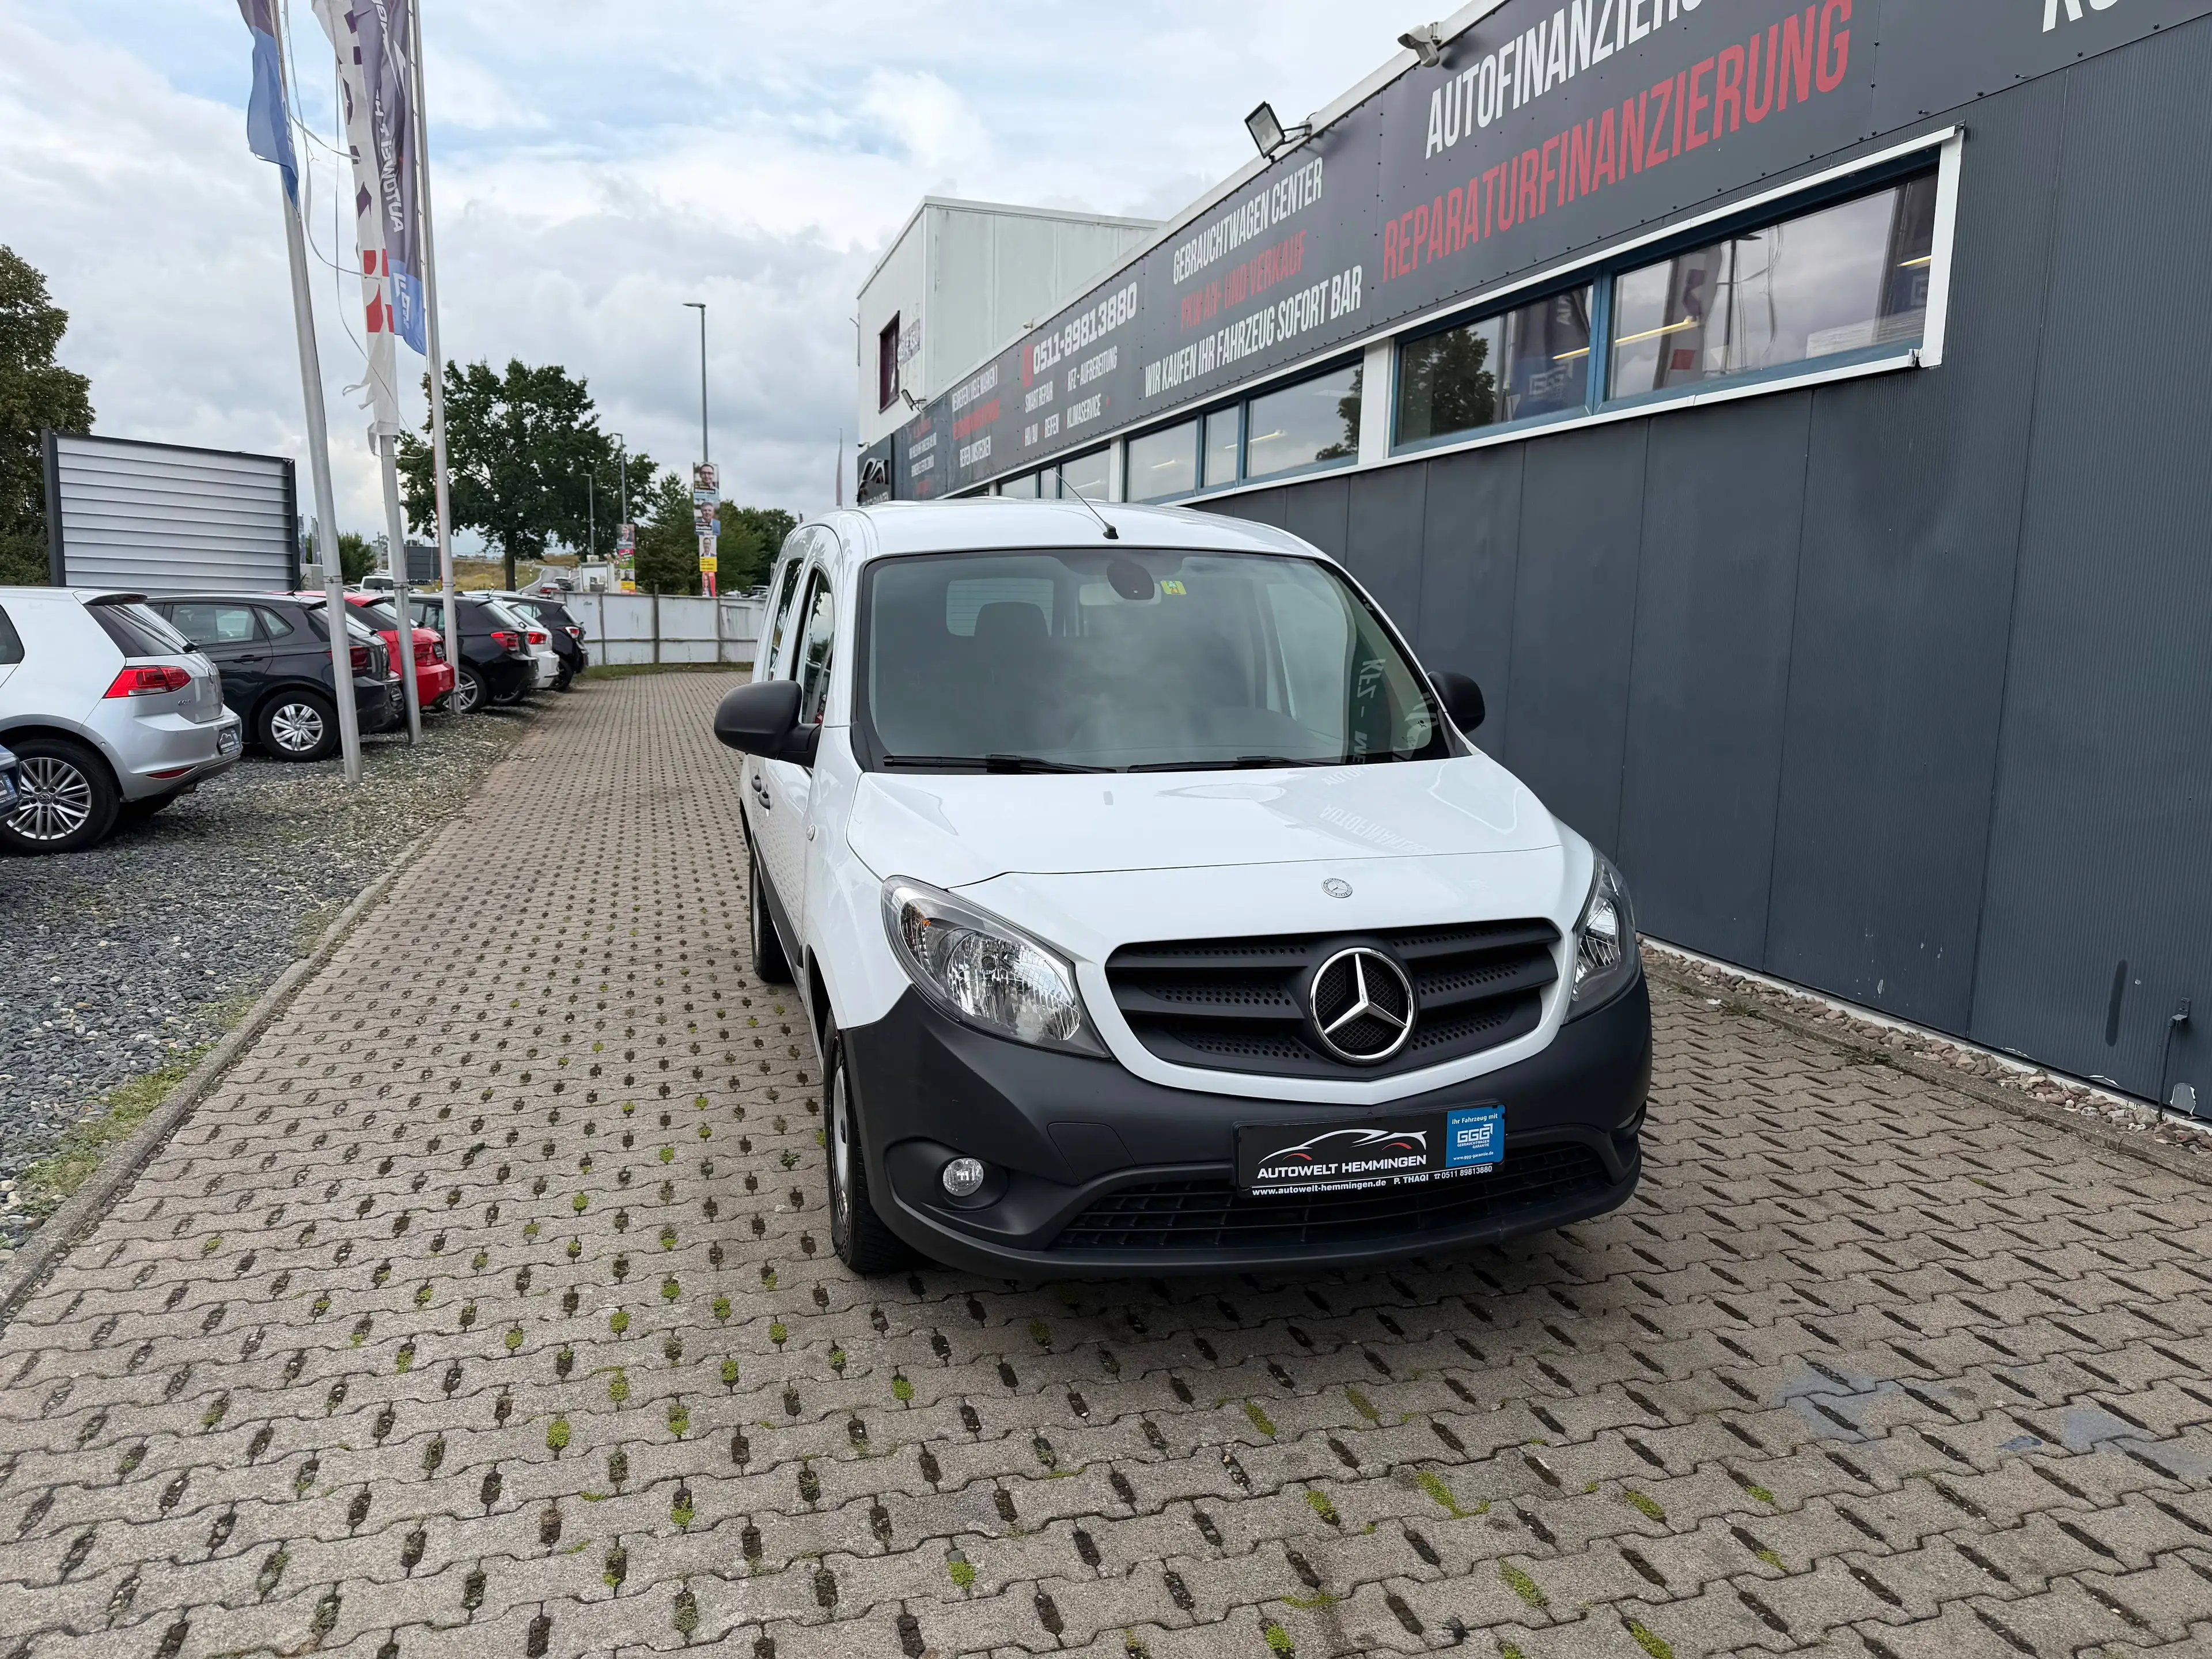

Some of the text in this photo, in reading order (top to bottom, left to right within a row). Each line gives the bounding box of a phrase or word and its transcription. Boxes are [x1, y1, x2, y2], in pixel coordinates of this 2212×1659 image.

[1384, 0, 1851, 283] REPARATURFINANZIERUNG
[1173, 157, 1323, 285] GEBRAUCHTWAGEN CENTER
[1181, 290, 1203, 332] PKW
[1225, 263, 1248, 309] UND
[1250, 228, 1307, 296] VERKAUF
[1033, 282, 1137, 374] 0511-89813880
[1145, 265, 1362, 398] WIR KAUFEN IHR FAHRZEUG SOFORT BAR
[1067, 368, 1077, 392] KFZ
[1462, 1115, 1487, 1123] Fahrzeug
[1252, 1179, 1387, 1196] www.autowelt-hemmingen.de
[1403, 1174, 1429, 1184] THAQI
[1441, 1171, 1457, 1179] 0511
[1460, 1165, 1493, 1176] 89813880
[1257, 1154, 1426, 1179] AUTOWELT HEMMINGEN
[1453, 1151, 1494, 1160] www.ggg-garantie.de
